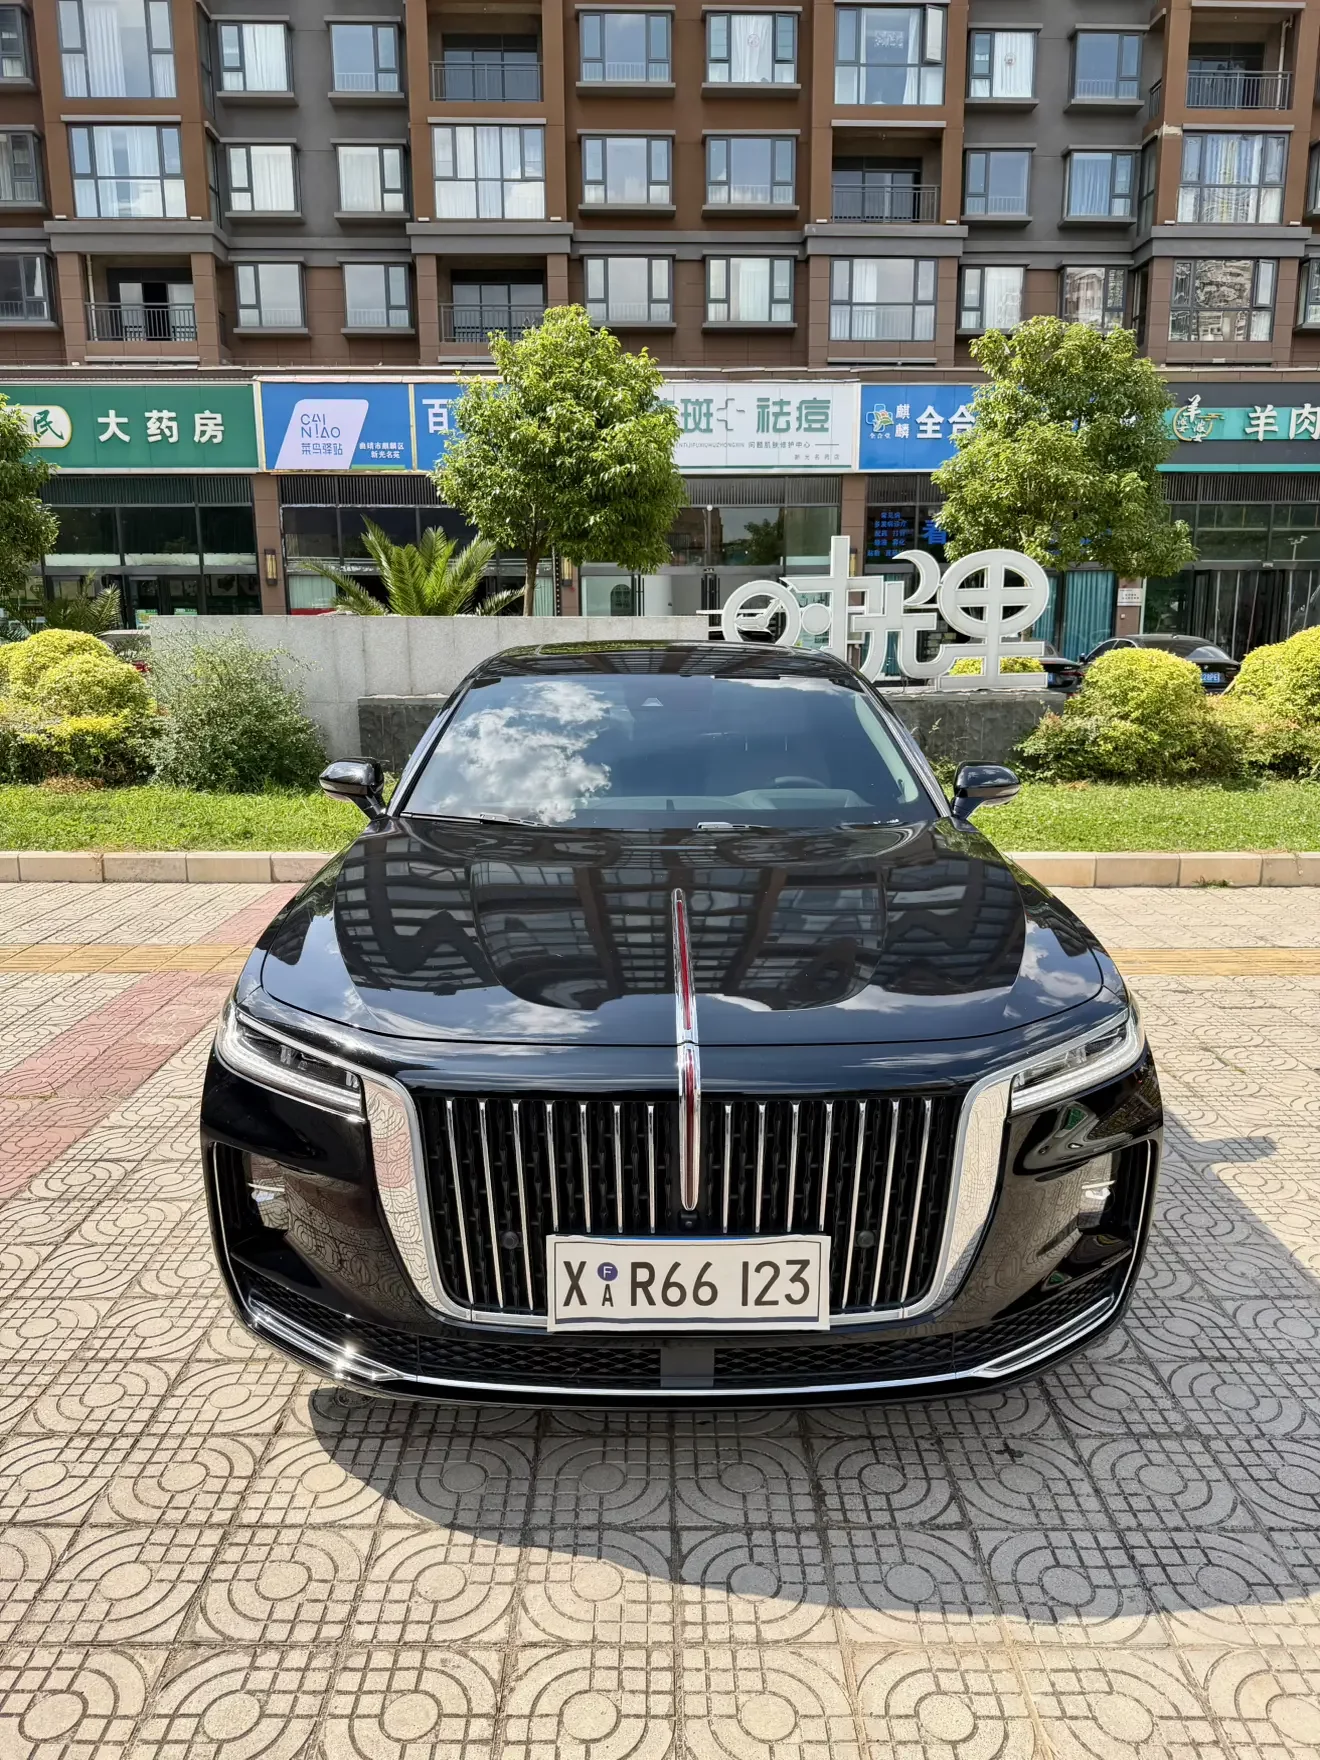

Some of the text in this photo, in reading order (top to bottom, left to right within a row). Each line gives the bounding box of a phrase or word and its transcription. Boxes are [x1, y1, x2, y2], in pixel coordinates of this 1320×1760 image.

[33, 409, 65, 441] 民
[97, 409, 225, 444] 大药房
[300, 413, 326, 426] CAI
[421, 398, 452, 434] 百
[756, 397, 831, 433] 祛痘
[894, 403, 910, 439] 麒麟
[1245, 403, 1320, 442] 羊肉
[301, 442, 343, 456] 菜鸟驿站
[748, 441, 811, 449] 问题肌肤修护中心
[630, 1260, 718, 1307] R66
[741, 1259, 811, 1307] 123
